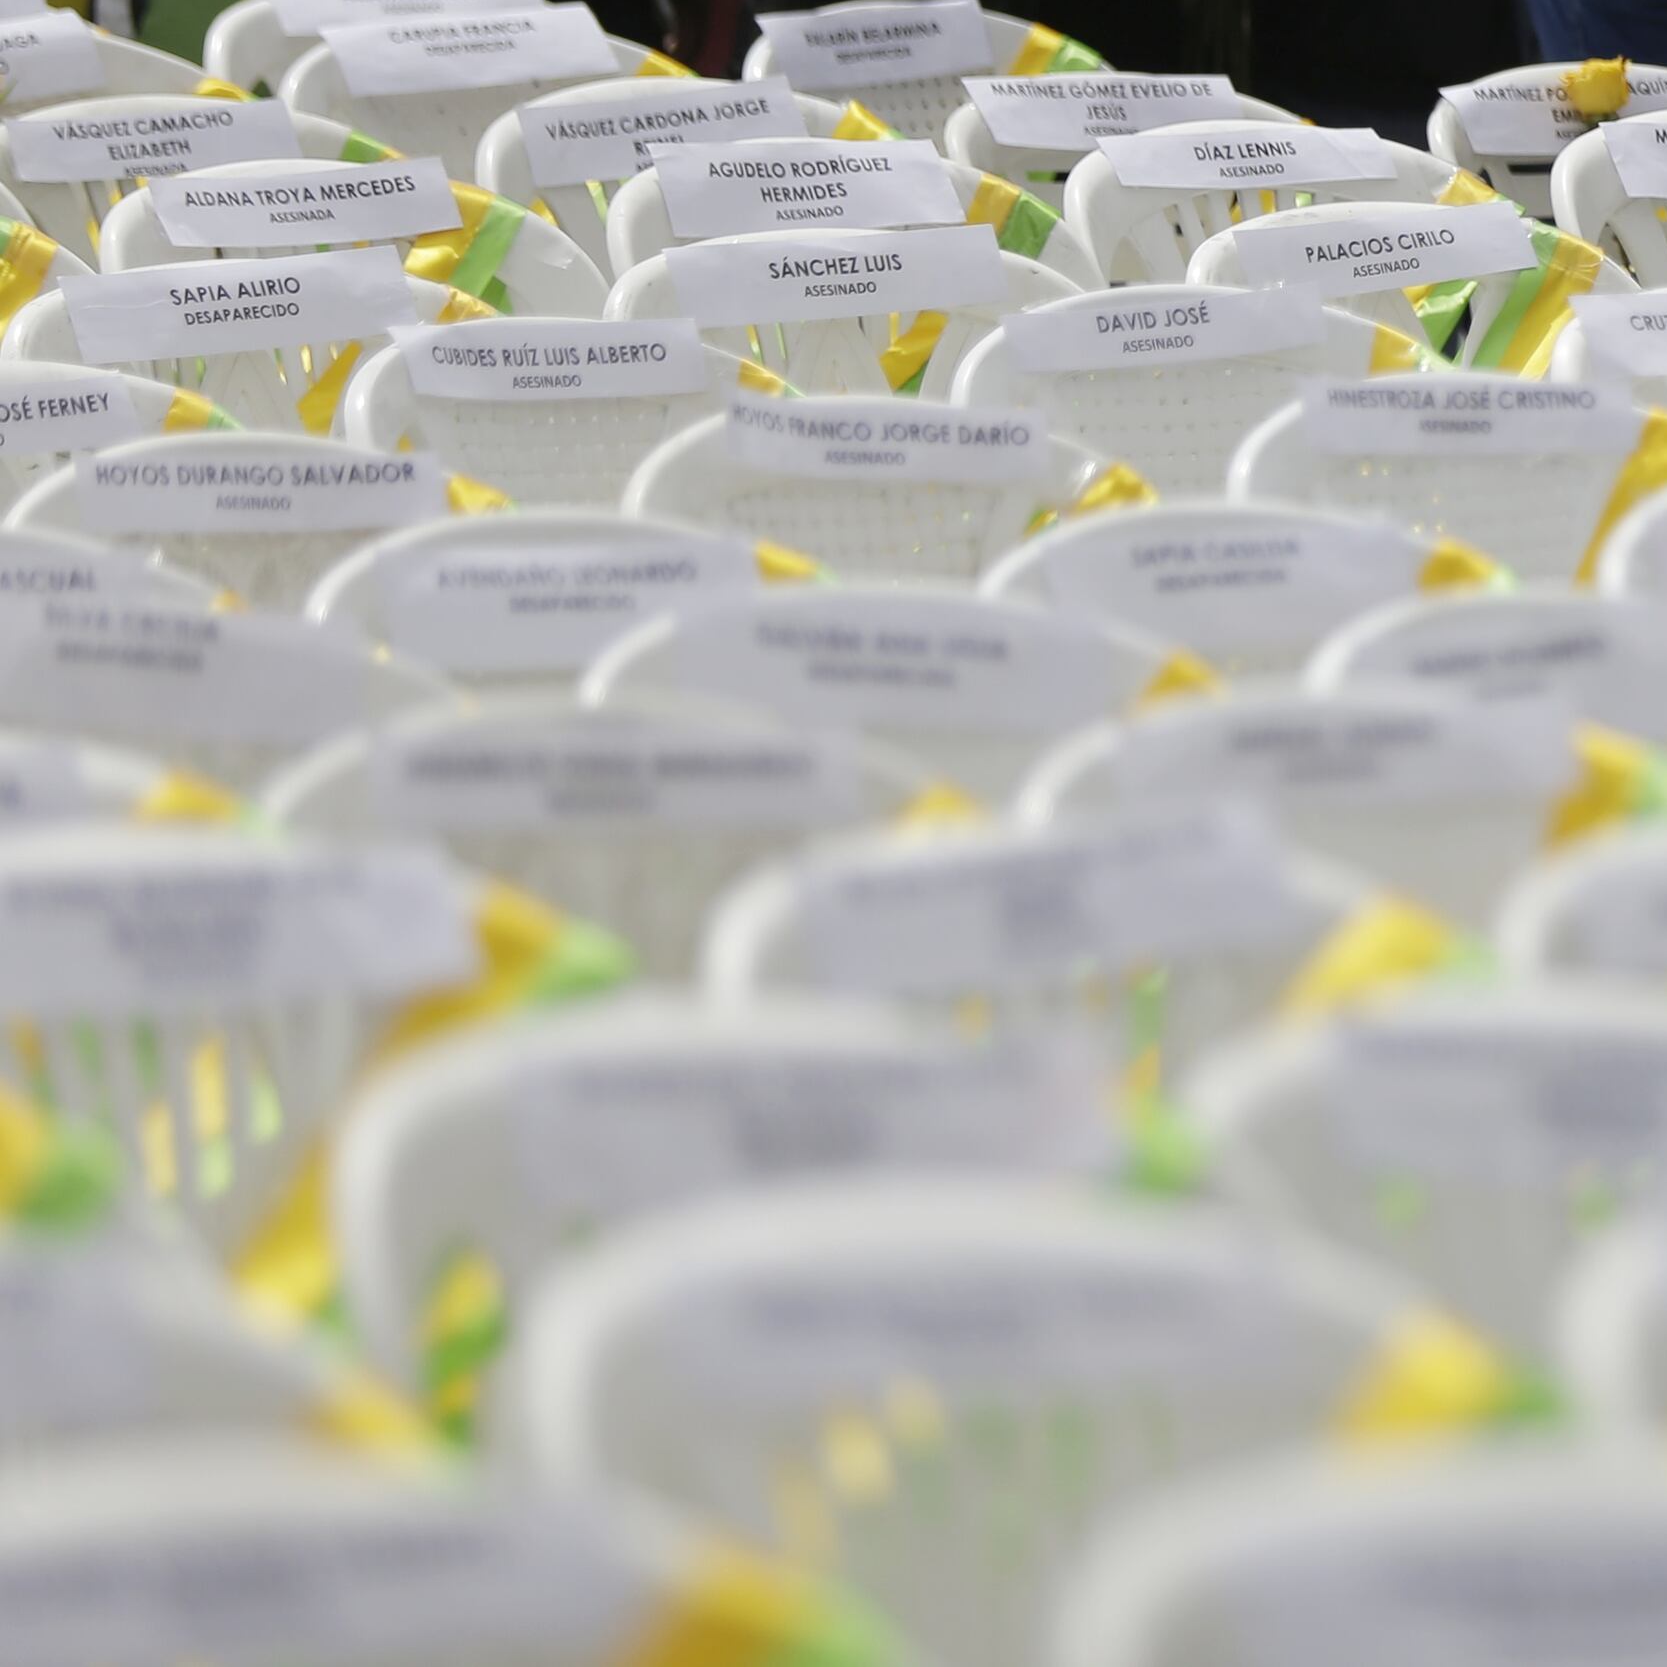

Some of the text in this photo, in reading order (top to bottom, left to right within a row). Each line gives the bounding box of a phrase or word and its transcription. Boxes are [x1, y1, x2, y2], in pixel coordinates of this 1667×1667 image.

[991, 80, 1213, 100] MARTÍNEZ GÓMEZ EVELIO DE
[1473, 85, 1541, 102] MARTÍNEZ
[545, 99, 770, 142] VÁSQUEZ CARDONA JORGE
[1086, 104, 1128, 121] JESÚS
[53, 110, 235, 142] VÁSQUEZ CAMACHO
[107, 139, 193, 162] ELIZABETH
[1193, 140, 1298, 162] DÍAZ LENNIS
[708, 154, 893, 179] AGUDELO RODRÍGUEZ
[1219, 162, 1285, 178] ASESINADO
[184, 175, 417, 208] ALDANA TROYA MERCEDES
[760, 182, 848, 203] HERMIDES
[269, 207, 336, 225] ASESINADA
[775, 205, 845, 222] ASESINADO
[1305, 228, 1455, 263] PALACIOS CIRILO
[768, 253, 902, 279] SÁNCHEZ LUIS
[1352, 257, 1421, 279] ASESINADO
[169, 276, 301, 307] SAPIA ALIRIO
[804, 281, 877, 300] ASESINADO
[184, 301, 300, 327] DESAPARECIDO
[1096, 300, 1211, 334] DAVID JOSÉ
[431, 343, 667, 368] CUBIDES RUÍZ LUIS ALBERTO
[1122, 334, 1195, 354] ASESINADO
[512, 373, 583, 390] ASESINADO
[38, 392, 109, 419] FERNEY
[1327, 386, 1597, 413] HINESTROZA JOSÉ CRISTINO
[879, 422, 952, 445] JORGE
[957, 418, 1032, 446] DARÍO
[176, 465, 286, 487] DURANGO
[290, 462, 416, 487] SALVADOR
